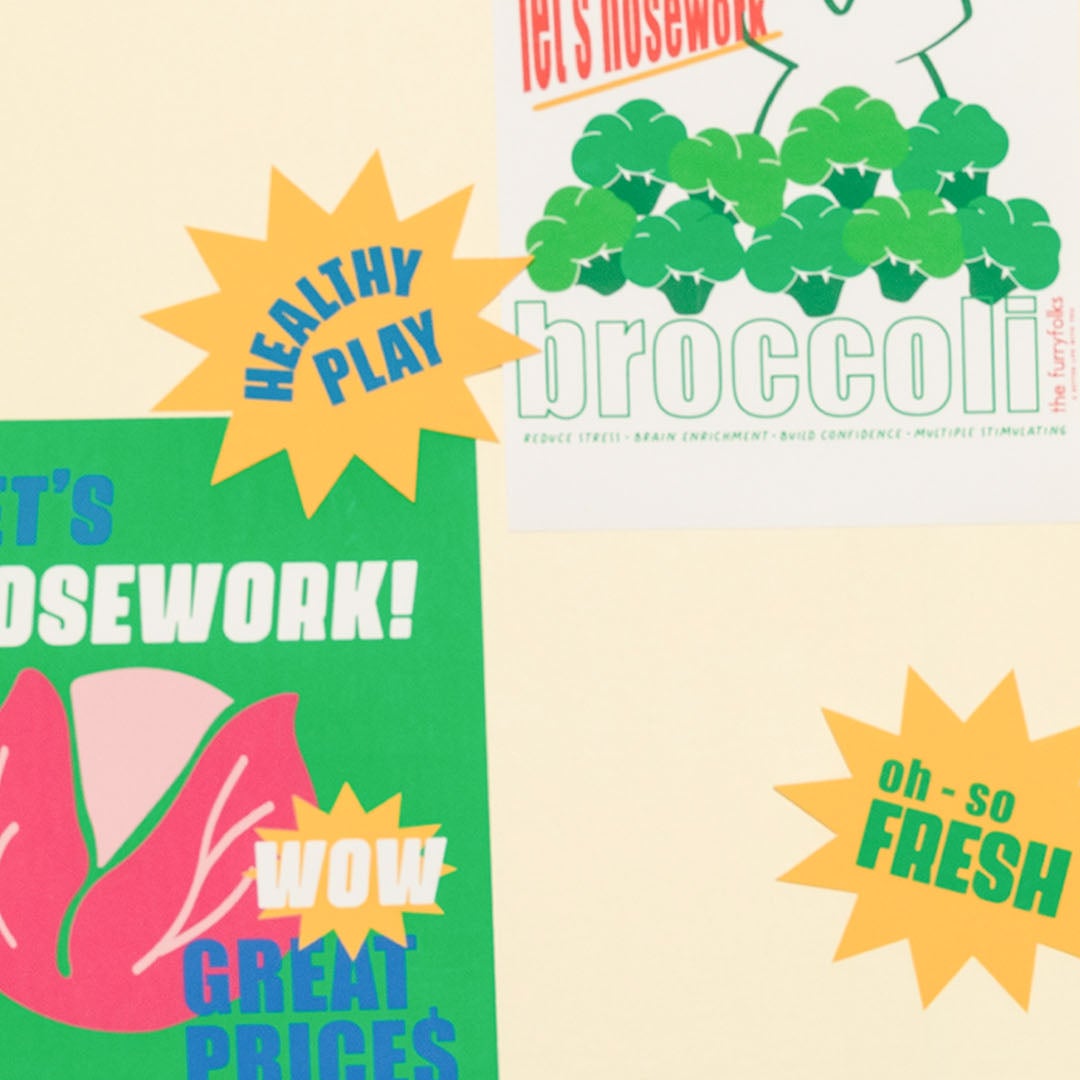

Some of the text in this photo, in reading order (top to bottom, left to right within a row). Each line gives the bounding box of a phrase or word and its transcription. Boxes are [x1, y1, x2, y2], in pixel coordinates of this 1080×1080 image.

[244, 245, 423, 402] HEALTHY
[312, 308, 443, 406] PLAY
[514, 295, 1040, 421] broccoli
[523, 425, 1067, 445] REDUCE STRESS BRAIN ENRICHMENT BUILD CONFIDENCE MULTIPLE STIMULATING
[1047, 384, 1067, 414] the
[0, 468, 115, 547] T'S
[878, 757, 932, 803] oh
[965, 782, 1016, 824] so
[254, 836, 448, 910] WOW
[855, 798, 1073, 919] FRESH
[182, 934, 418, 1017] GREAT
